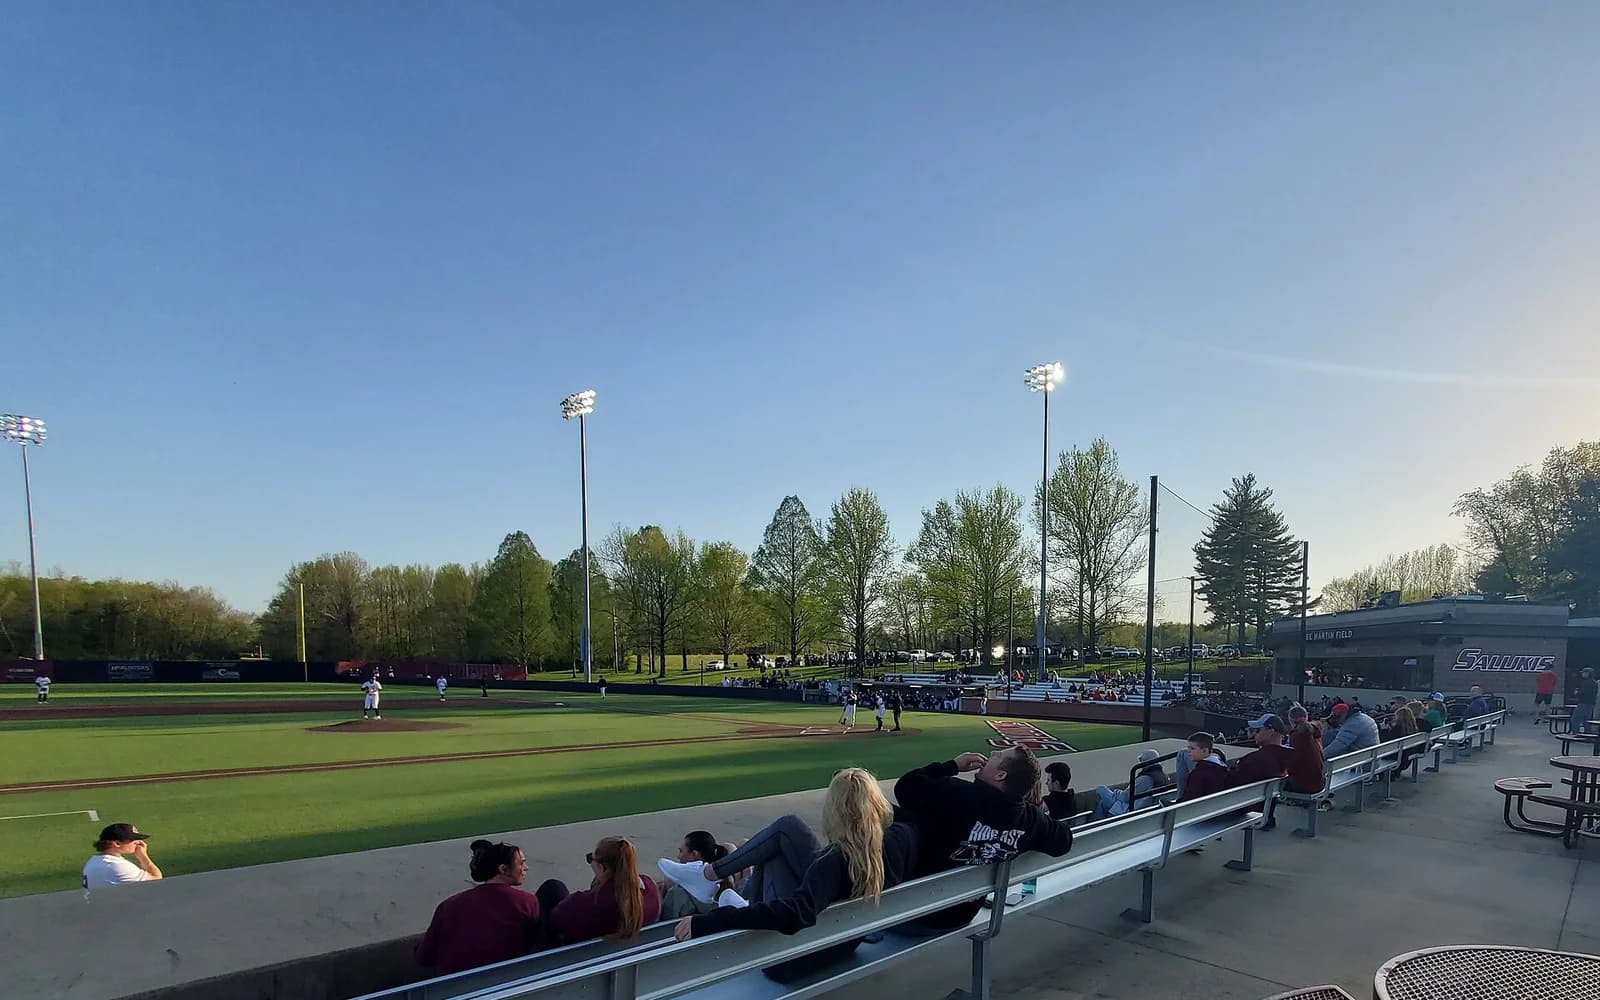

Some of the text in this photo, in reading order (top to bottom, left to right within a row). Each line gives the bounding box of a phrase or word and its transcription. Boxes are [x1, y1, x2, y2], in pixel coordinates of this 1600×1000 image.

[1313, 631, 1335, 640] MARTIN
[1336, 630, 1353, 639] FIELD
[1452, 648, 1555, 672] SALUKIS
